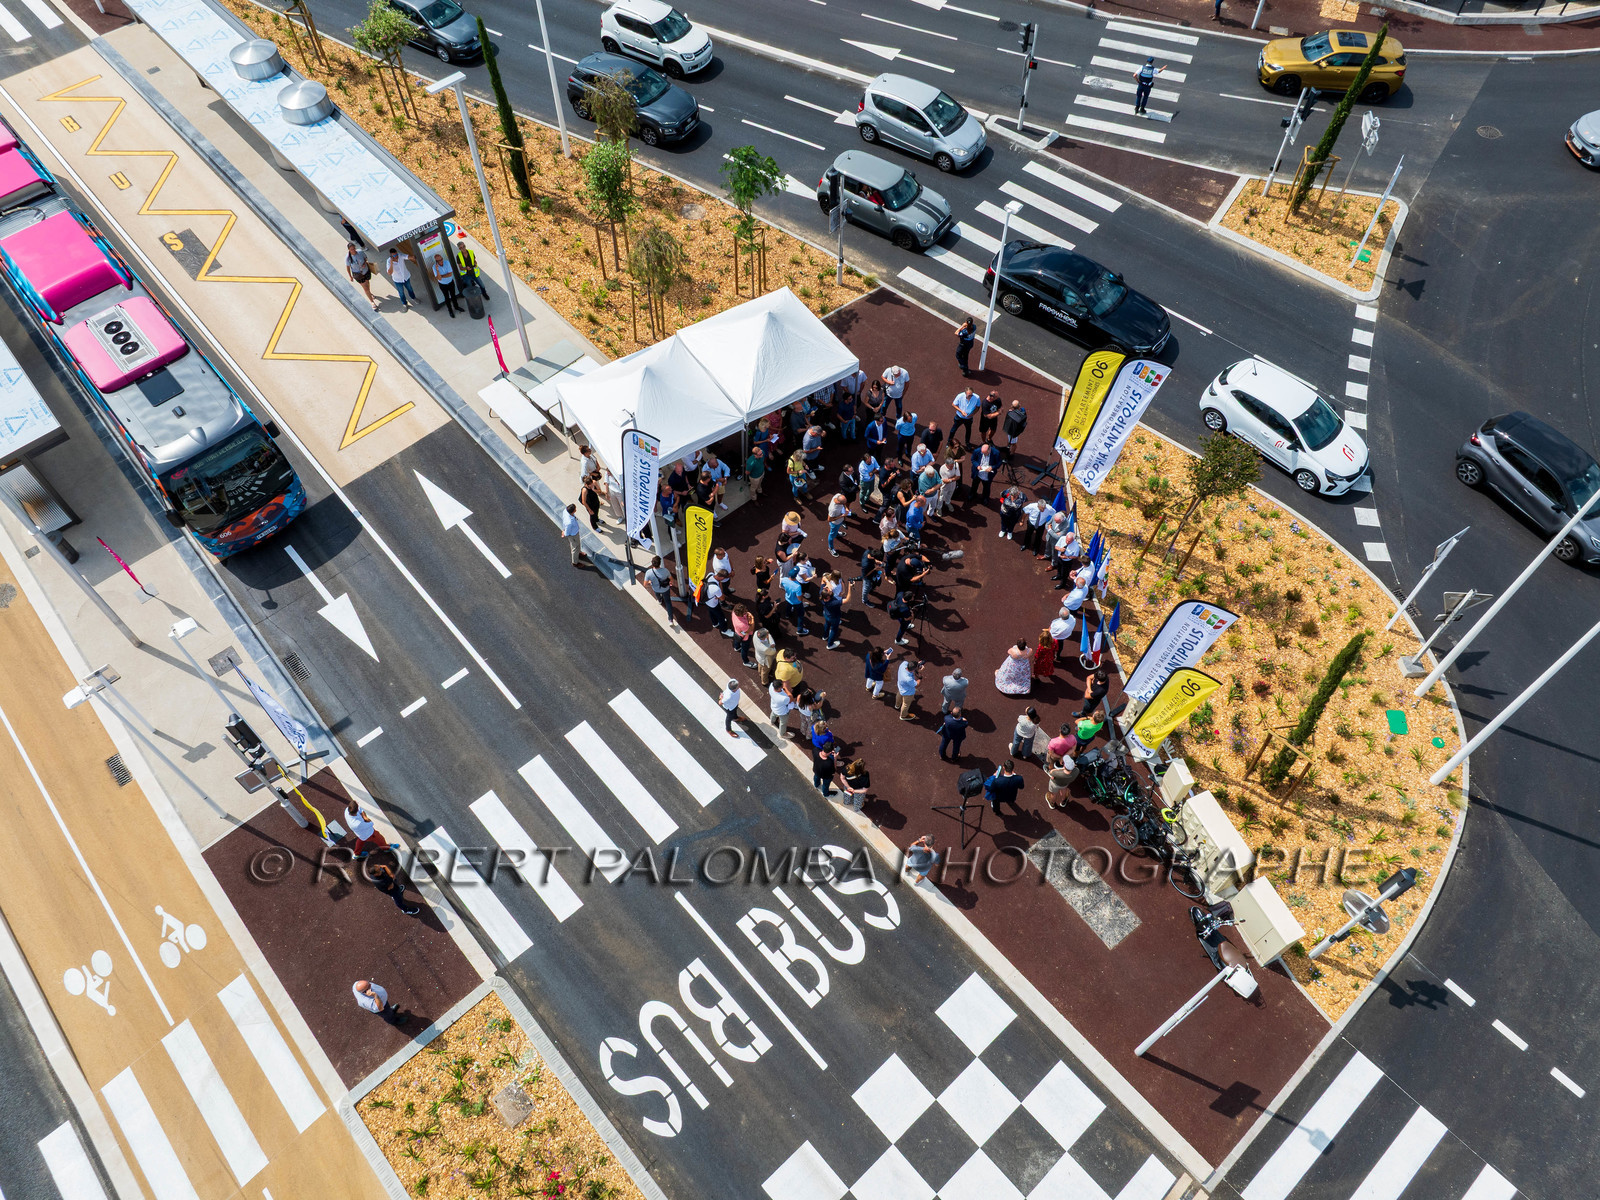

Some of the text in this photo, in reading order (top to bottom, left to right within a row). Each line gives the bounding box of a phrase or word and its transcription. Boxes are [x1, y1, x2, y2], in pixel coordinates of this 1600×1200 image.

[397, 219, 438, 243] WEISWEILLER
[1091, 360, 1109, 379] 06
[1104, 388, 1142, 453] ANTIPOLIS
[639, 458, 651, 516] ANTIPOLIS
[695, 513, 708, 532] 06
[1166, 626, 1205, 678] ANTIPOLIS
[1180, 678, 1201, 698] 06
[735, 844, 901, 1009] BUS
[599, 957, 774, 1138] BUS
